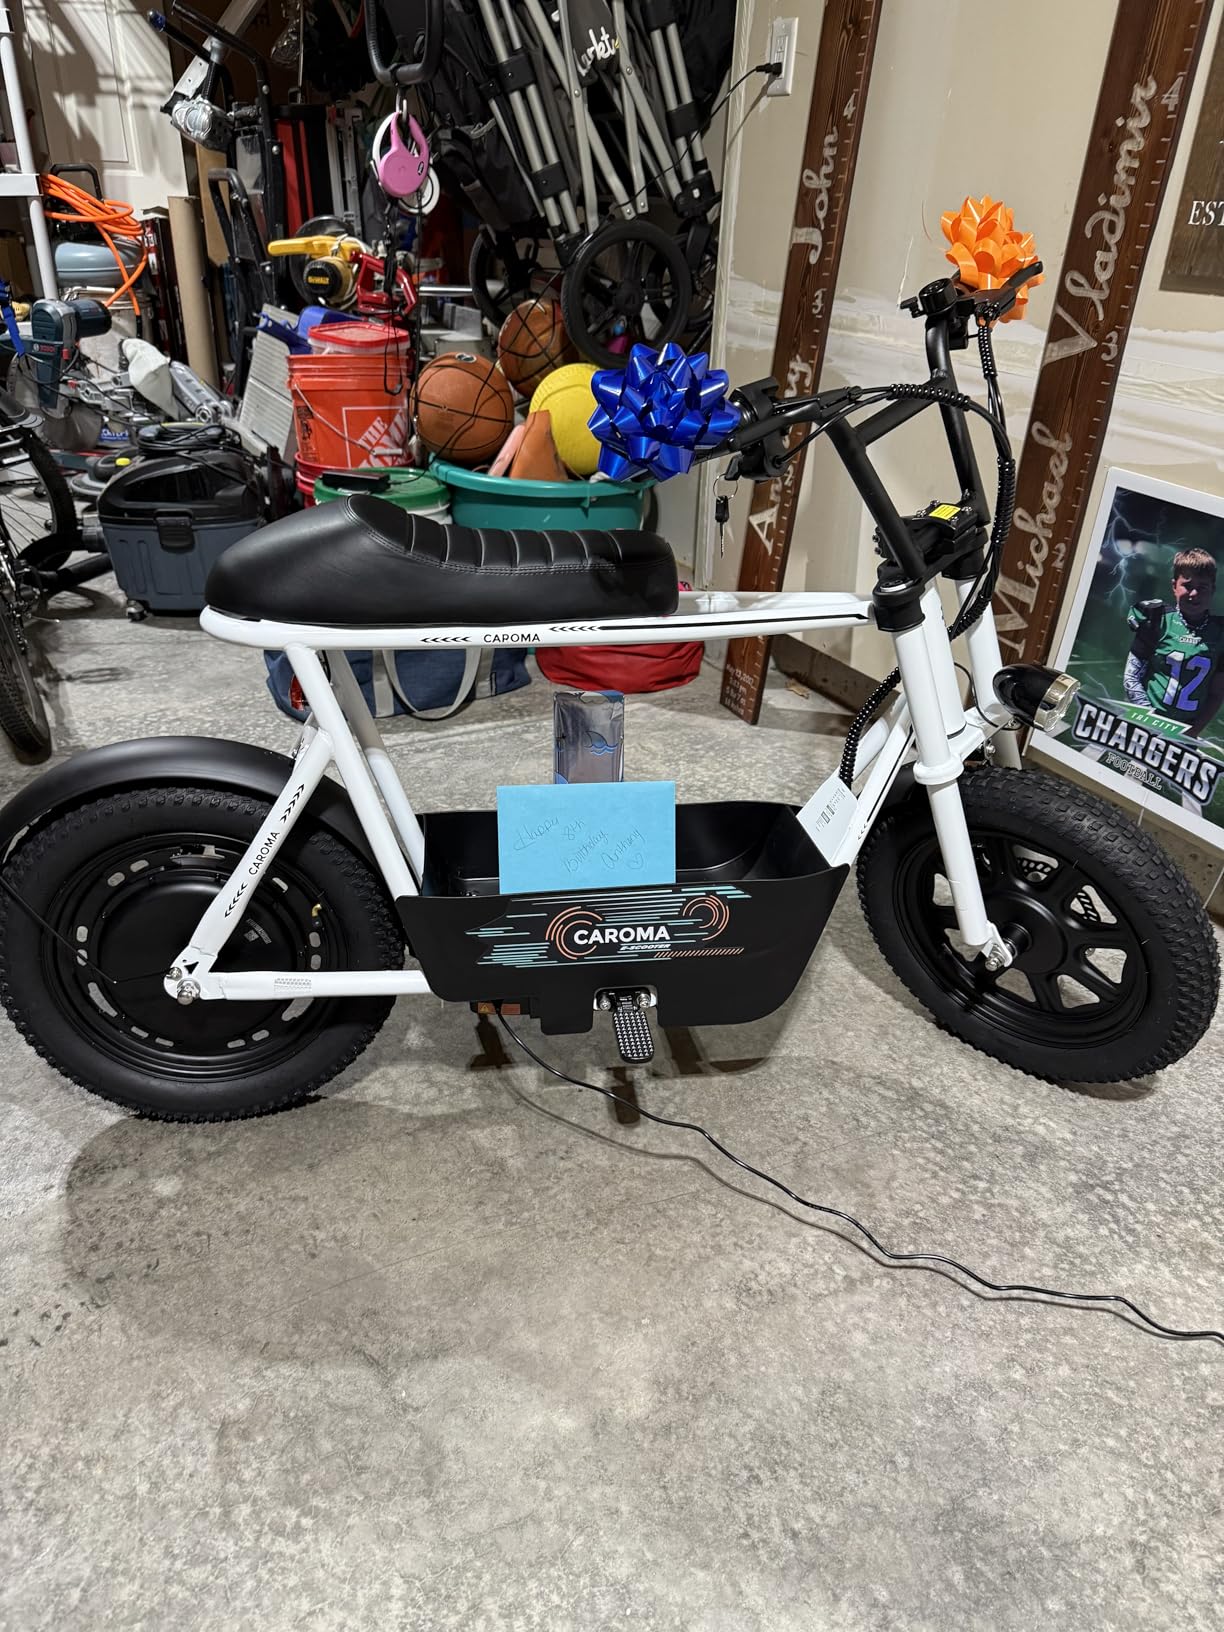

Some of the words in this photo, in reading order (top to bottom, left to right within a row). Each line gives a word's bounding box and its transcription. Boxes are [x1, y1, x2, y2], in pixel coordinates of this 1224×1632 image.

[843, 92, 857, 120] 4
[1160, 75, 1184, 112] 4
[791, 126, 839, 265] John
[1042, 75, 1158, 369] Vladimir
[1100, 330, 1120, 361] 3
[358, 416, 388, 450] THE
[994, 420, 1073, 660] Michael
[1051, 541, 1067, 569] 2
[1163, 651, 1212, 712] 12
[1131, 711, 1148, 724] TRI
[1151, 719, 1179, 732] CITY
[1075, 703, 1217, 801] CHARGERS
[1106, 752, 1163, 790] FOOTBALL
[248, 831, 280, 876] CAROMA
[573, 925, 671, 945] CAROMA
